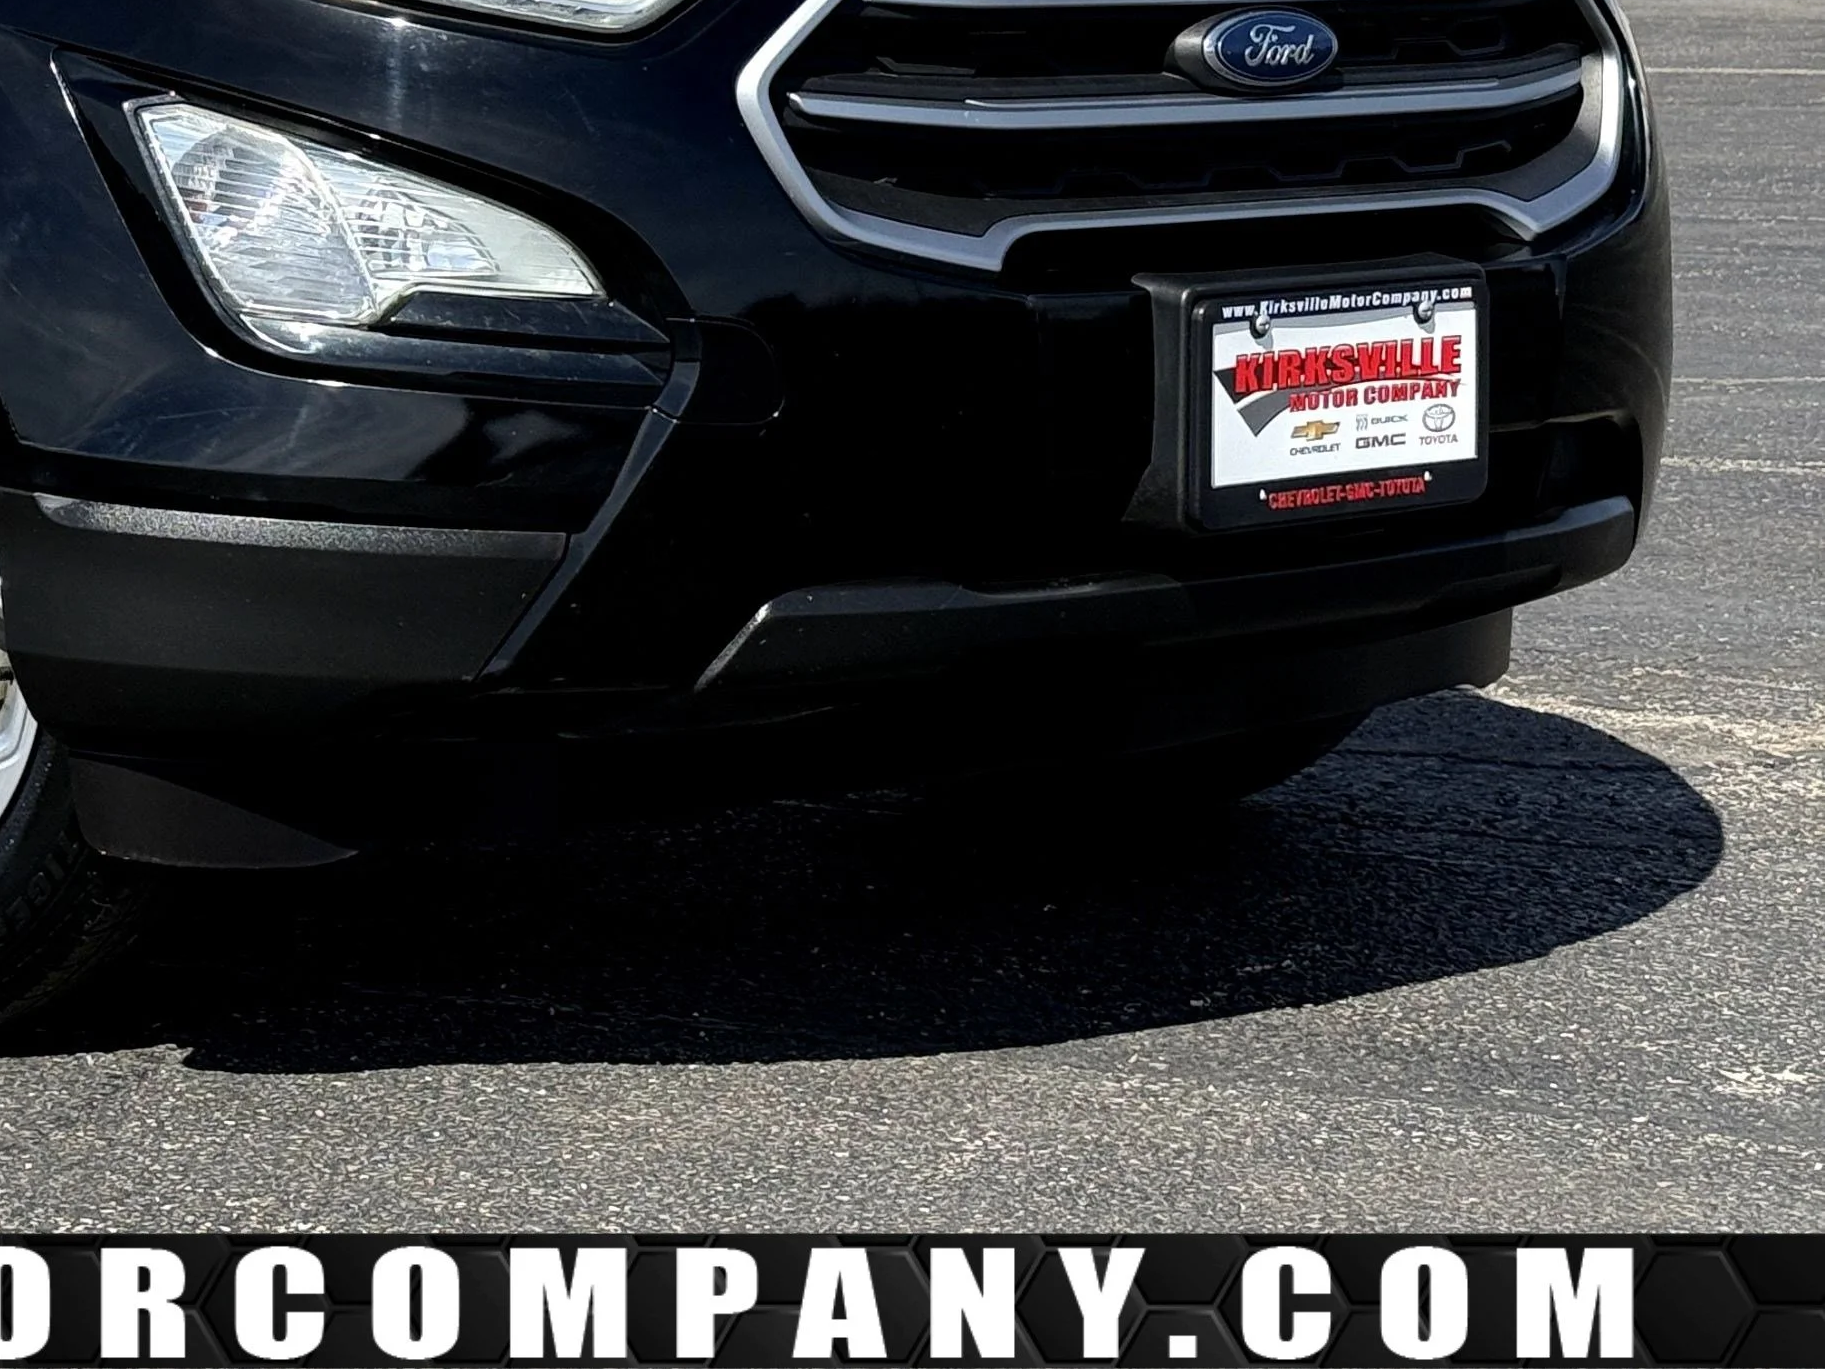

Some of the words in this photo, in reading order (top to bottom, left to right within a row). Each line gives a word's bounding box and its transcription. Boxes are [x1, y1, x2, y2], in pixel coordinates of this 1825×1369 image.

[1243, 23, 1316, 68] Ford
[1233, 335, 1462, 394] KIRKSVILLE
[1288, 387, 1359, 414] MOTOR
[1363, 378, 1462, 405] COMPANY
[1289, 442, 1342, 457] CHEVROLET
[1355, 432, 1407, 450] GMC
[1418, 433, 1459, 447] TOYOTA
